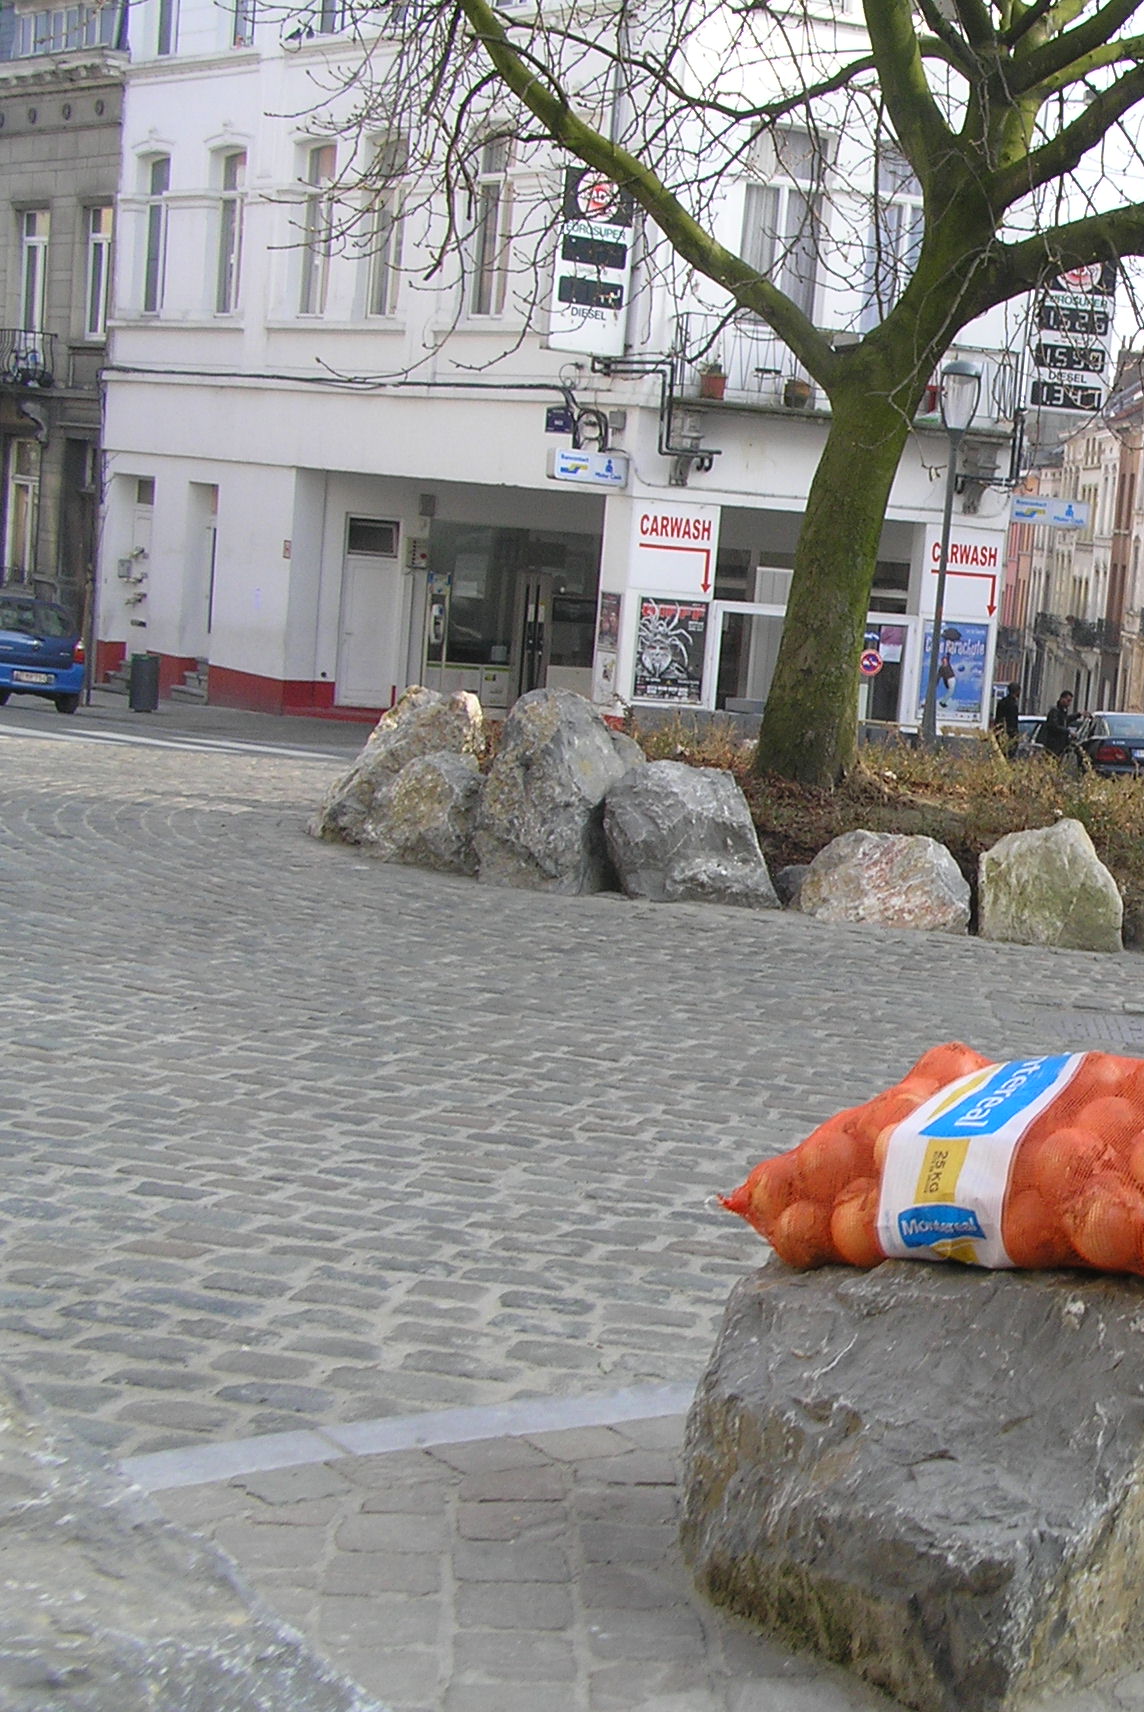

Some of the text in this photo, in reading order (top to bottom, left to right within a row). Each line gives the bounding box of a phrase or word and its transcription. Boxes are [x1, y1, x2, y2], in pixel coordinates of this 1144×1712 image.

[571, 306, 606, 321] DIESEL
[1049, 369, 1087, 384] DIESEL
[640, 514, 711, 541] CARWASH
[932, 542, 998, 567] CRWASH
